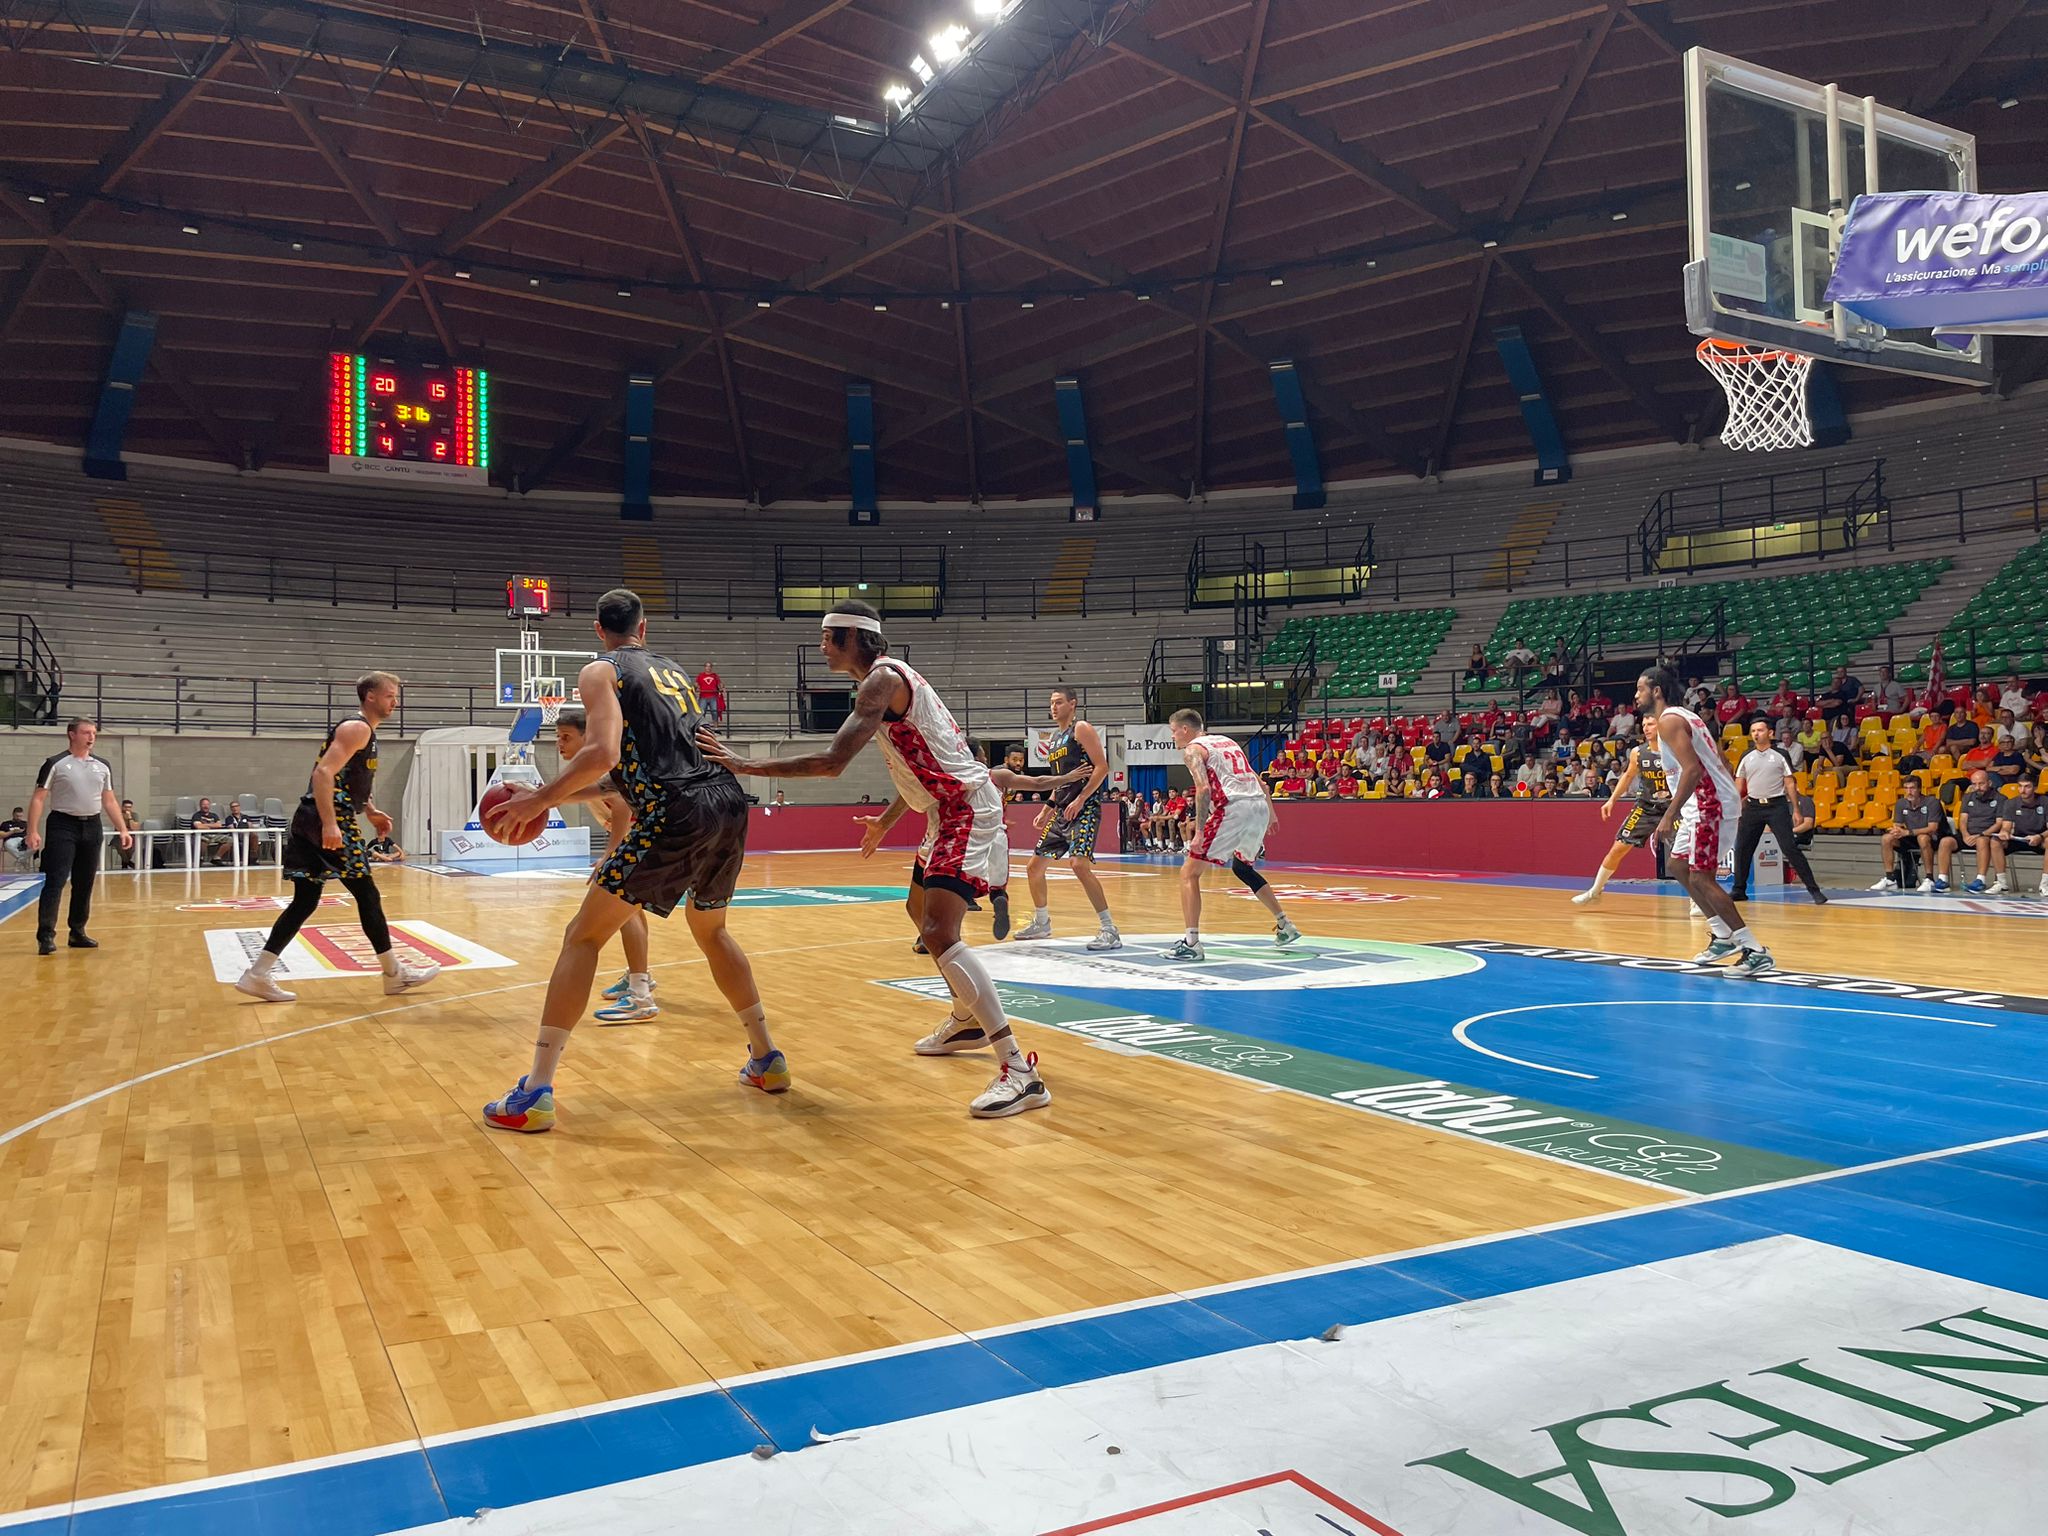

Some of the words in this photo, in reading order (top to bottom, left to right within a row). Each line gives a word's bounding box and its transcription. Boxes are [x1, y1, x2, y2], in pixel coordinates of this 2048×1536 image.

[1885, 267, 1978, 283] L'assicurazione.
[1981, 264, 2001, 275] Ma
[375, 377, 395, 392] 20
[432, 383, 446, 398] 15
[396, 405, 430, 422] 3:16
[382, 437, 393, 451] 4
[435, 442, 446, 456] 2
[523, 578, 547, 588] 3:16
[534, 589, 548, 609] 7
[1383, 677, 1392, 685] A4
[1127, 740, 1142, 750] La
[1223, 750, 1252, 774] 22
[1655, 780, 1665, 790] 14
[1456, 943, 2005, 1008] LATTOEDIL
[1170, 1049, 1246, 1071] NEUTRAL
[1528, 1142, 1672, 1181] NEUTRAL
